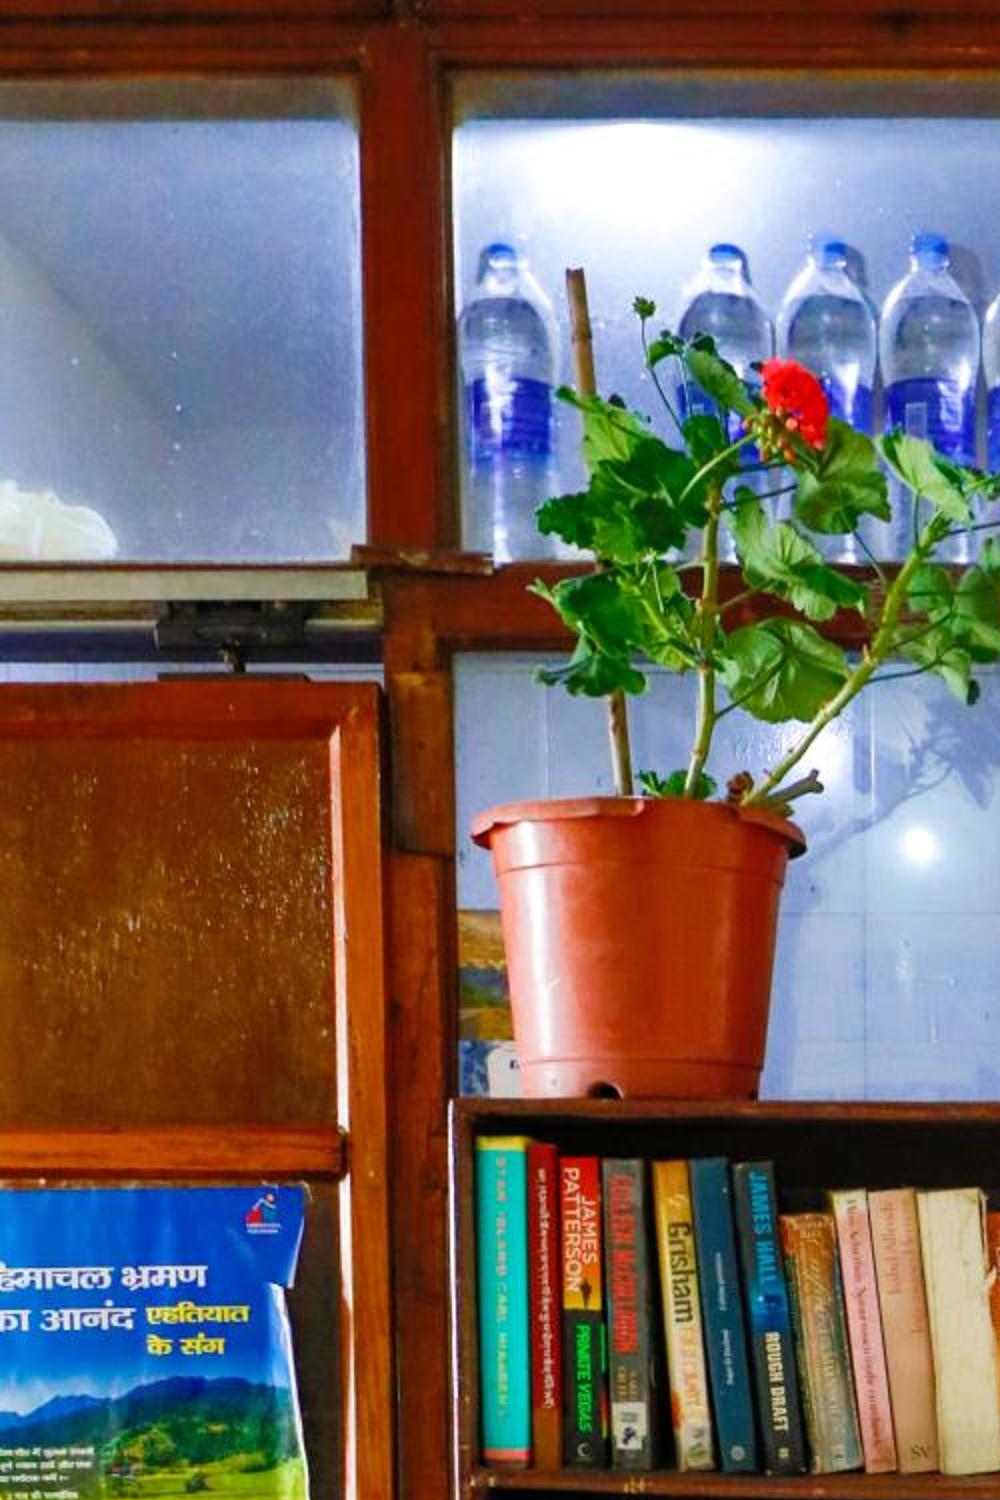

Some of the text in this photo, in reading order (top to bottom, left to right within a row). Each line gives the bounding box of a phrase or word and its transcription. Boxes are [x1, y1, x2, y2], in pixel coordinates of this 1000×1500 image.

[563, 1167, 581, 1293] PATTERSON
[582, 1196, 597, 1264] JAMES
[750, 1171, 777, 1282] JAMES HALL
[121, 1265, 209, 1291] भ्रमण
[145, 1301, 250, 1324] एहतियात
[667, 1221, 694, 1323] Grisham
[40, 1299, 136, 1331] आनंद
[146, 1332, 225, 1356] के संग
[576, 1324, 592, 1432] PRIVATE VEGAS
[764, 1332, 788, 1432] ROUGH DRAFT
